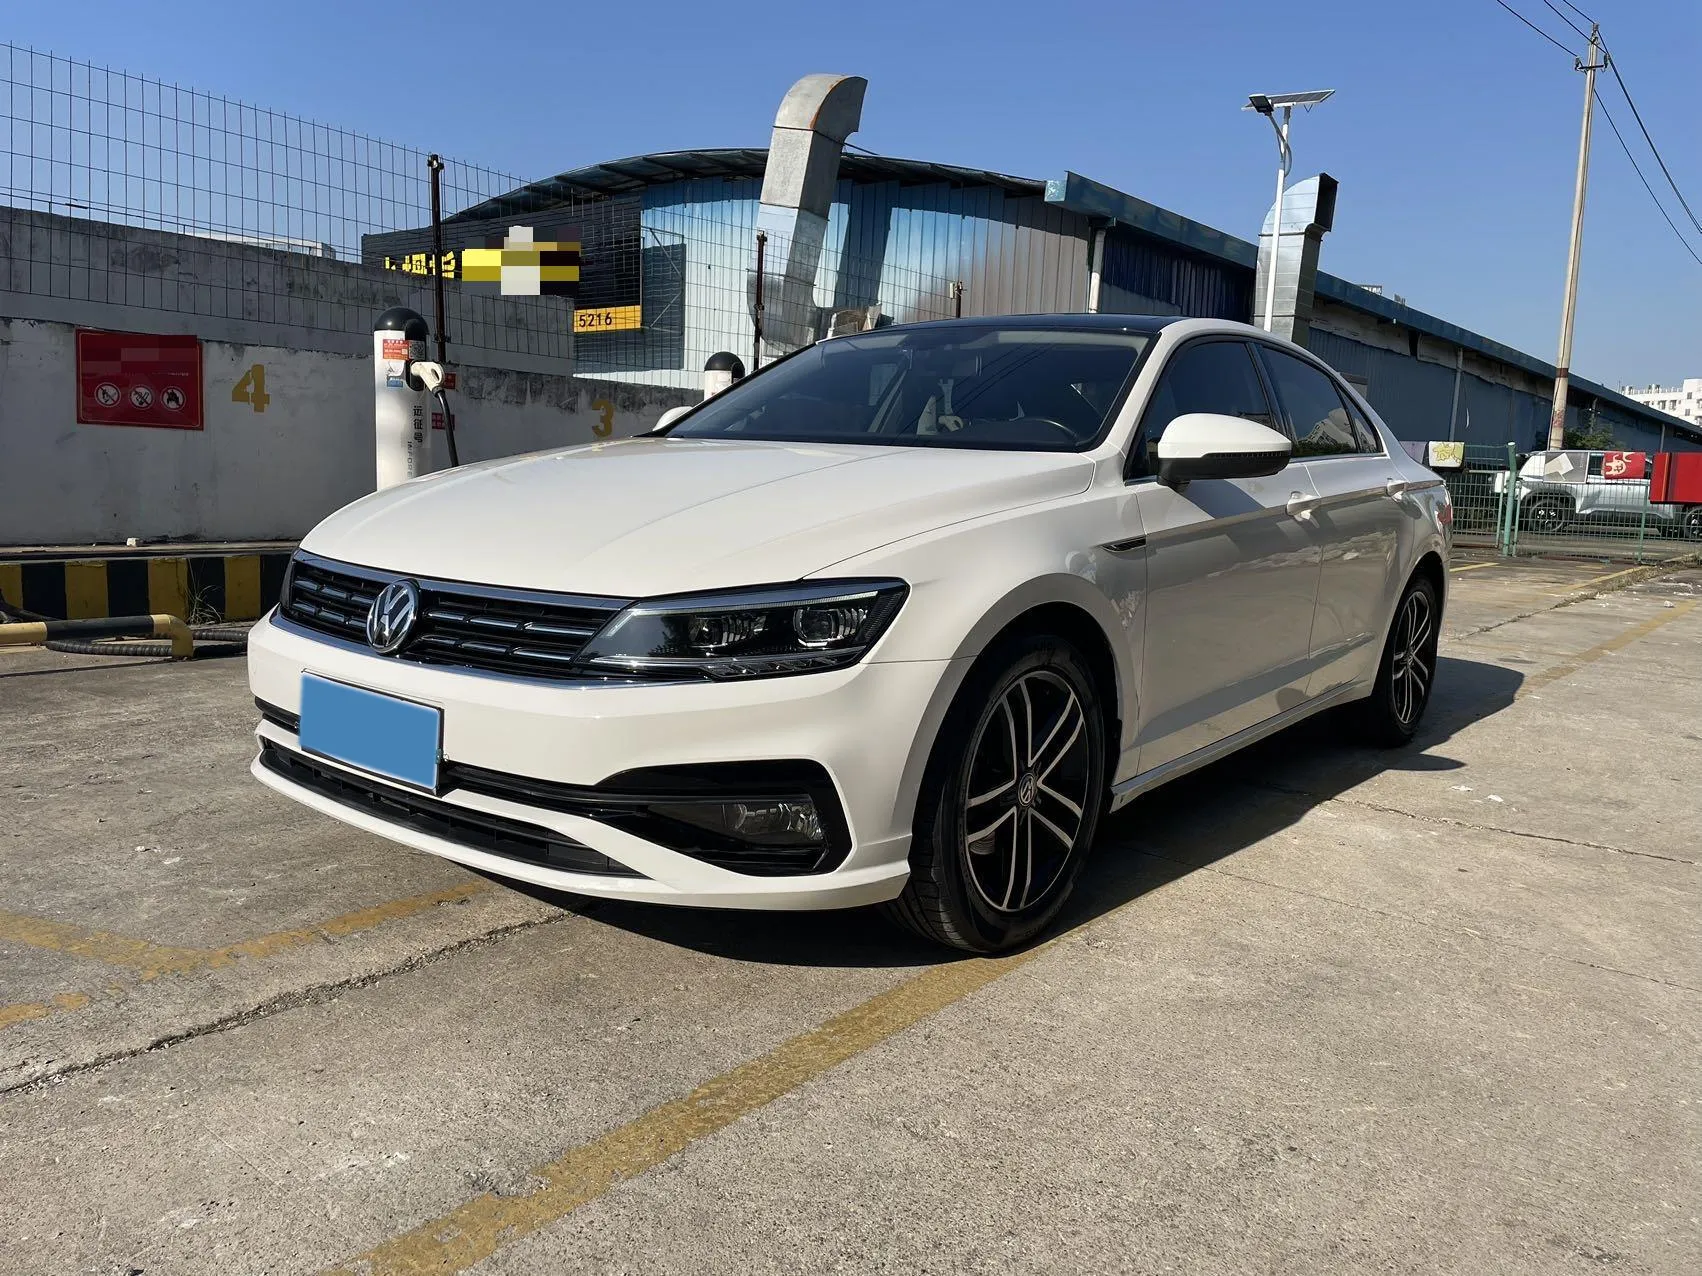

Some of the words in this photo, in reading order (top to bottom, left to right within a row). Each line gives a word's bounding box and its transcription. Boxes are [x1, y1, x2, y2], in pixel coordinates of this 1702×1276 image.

[578, 311, 613, 328] 5216
[232, 363, 271, 413] 4
[592, 398, 614, 438] 3
